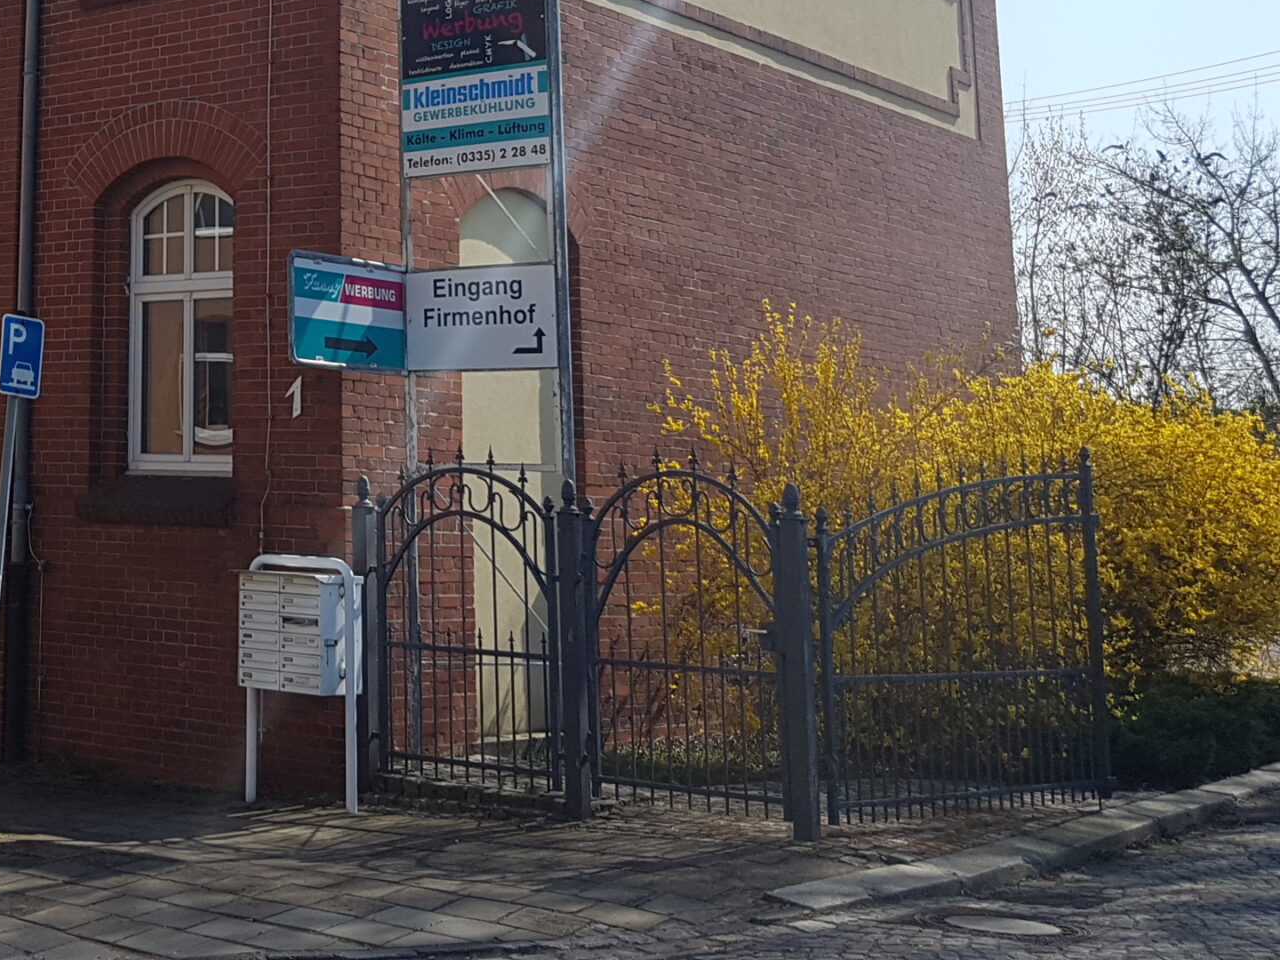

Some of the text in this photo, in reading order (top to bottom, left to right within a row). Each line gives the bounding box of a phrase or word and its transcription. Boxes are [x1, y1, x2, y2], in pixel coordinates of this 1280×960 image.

[422, 10, 525, 40] Werbung
[431, 37, 471, 52] DESIGN
[484, 34, 493, 64] CMYK
[413, 72, 535, 110] kleinschmidt
[413, 97, 536, 123] GEWERBEKÜHLUNG
[406, 133, 437, 146] Kälte
[449, 129, 484, 142] Klima
[498, 122, 545, 135] Lüftung
[407, 144, 546, 169] Telefon: (0335) 2 28 48
[345, 283, 396, 302] WERBUNG
[433, 278, 522, 301] Eingang
[423, 303, 536, 328] Firmenhof
[8, 322, 27, 355] P
[285, 375, 302, 419] 1
